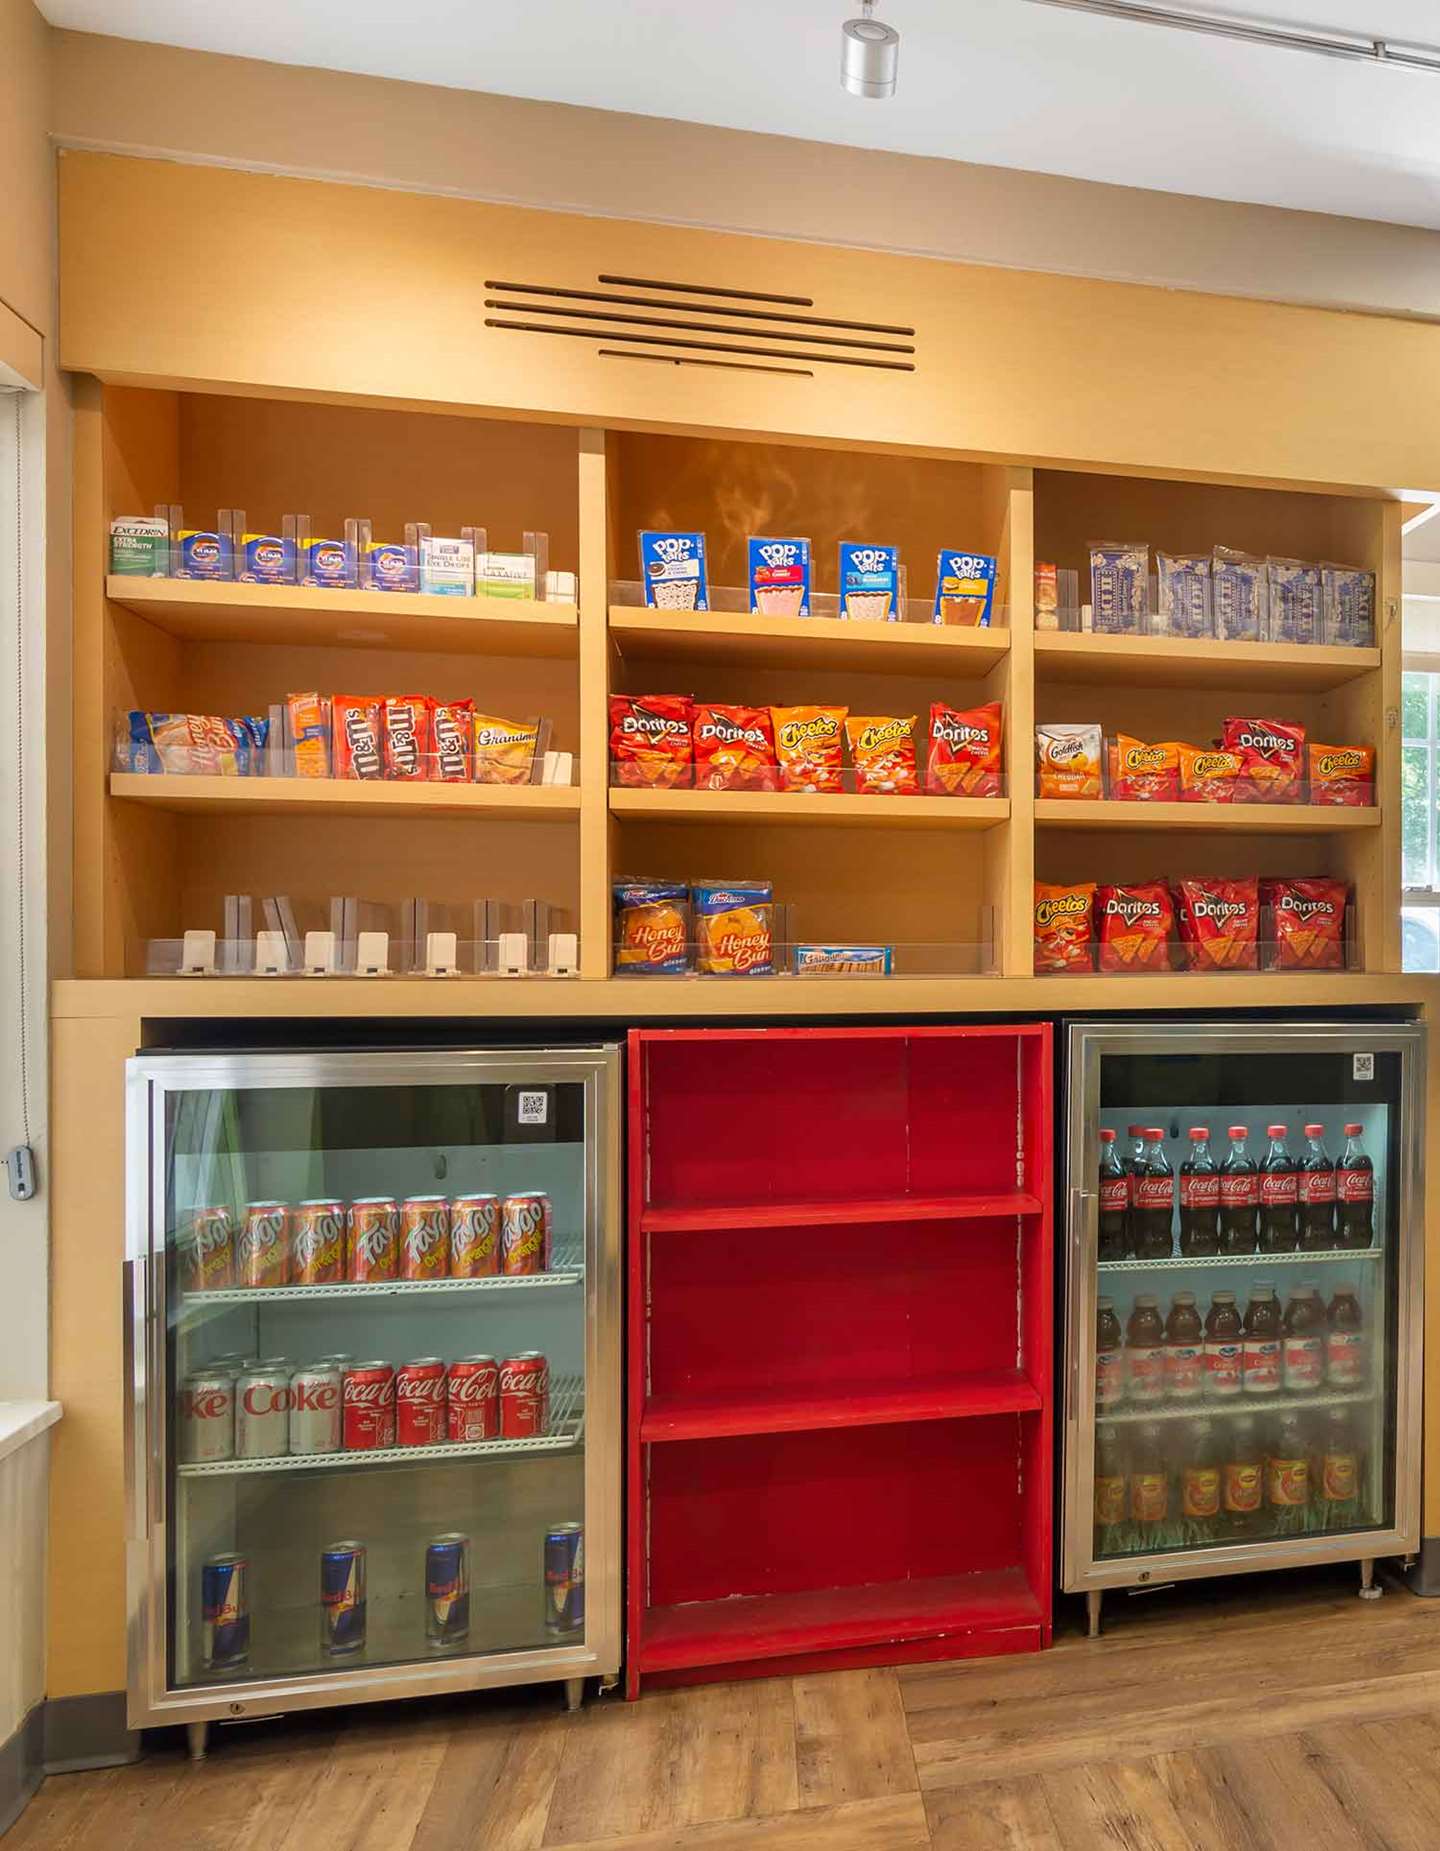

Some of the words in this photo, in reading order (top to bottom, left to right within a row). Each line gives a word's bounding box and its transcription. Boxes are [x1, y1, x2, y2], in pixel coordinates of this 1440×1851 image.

[623, 716, 688, 733] Doritos
[701, 723, 768, 745] Doritos
[781, 715, 838, 748] Cheetos
[858, 719, 912, 749] Cheetos
[932, 722, 989, 743] Doritos
[1051, 742, 1084, 759] Goldfish
[1240, 733, 1295, 750] Doritos
[1127, 749, 1165, 769] Cheetos
[1194, 755, 1233, 775] Cheetos
[1318, 752, 1361, 774] Cheetos
[1036, 896, 1088, 925] Cheetos
[1107, 900, 1160, 914] Doritos
[1194, 902, 1247, 917] Doritos
[1281, 896, 1334, 914] Doritos
[632, 926, 685, 944] Honey
[720, 931, 770, 955] Honey
[650, 941, 686, 961] Bun
[733, 948, 770, 970] Bun
